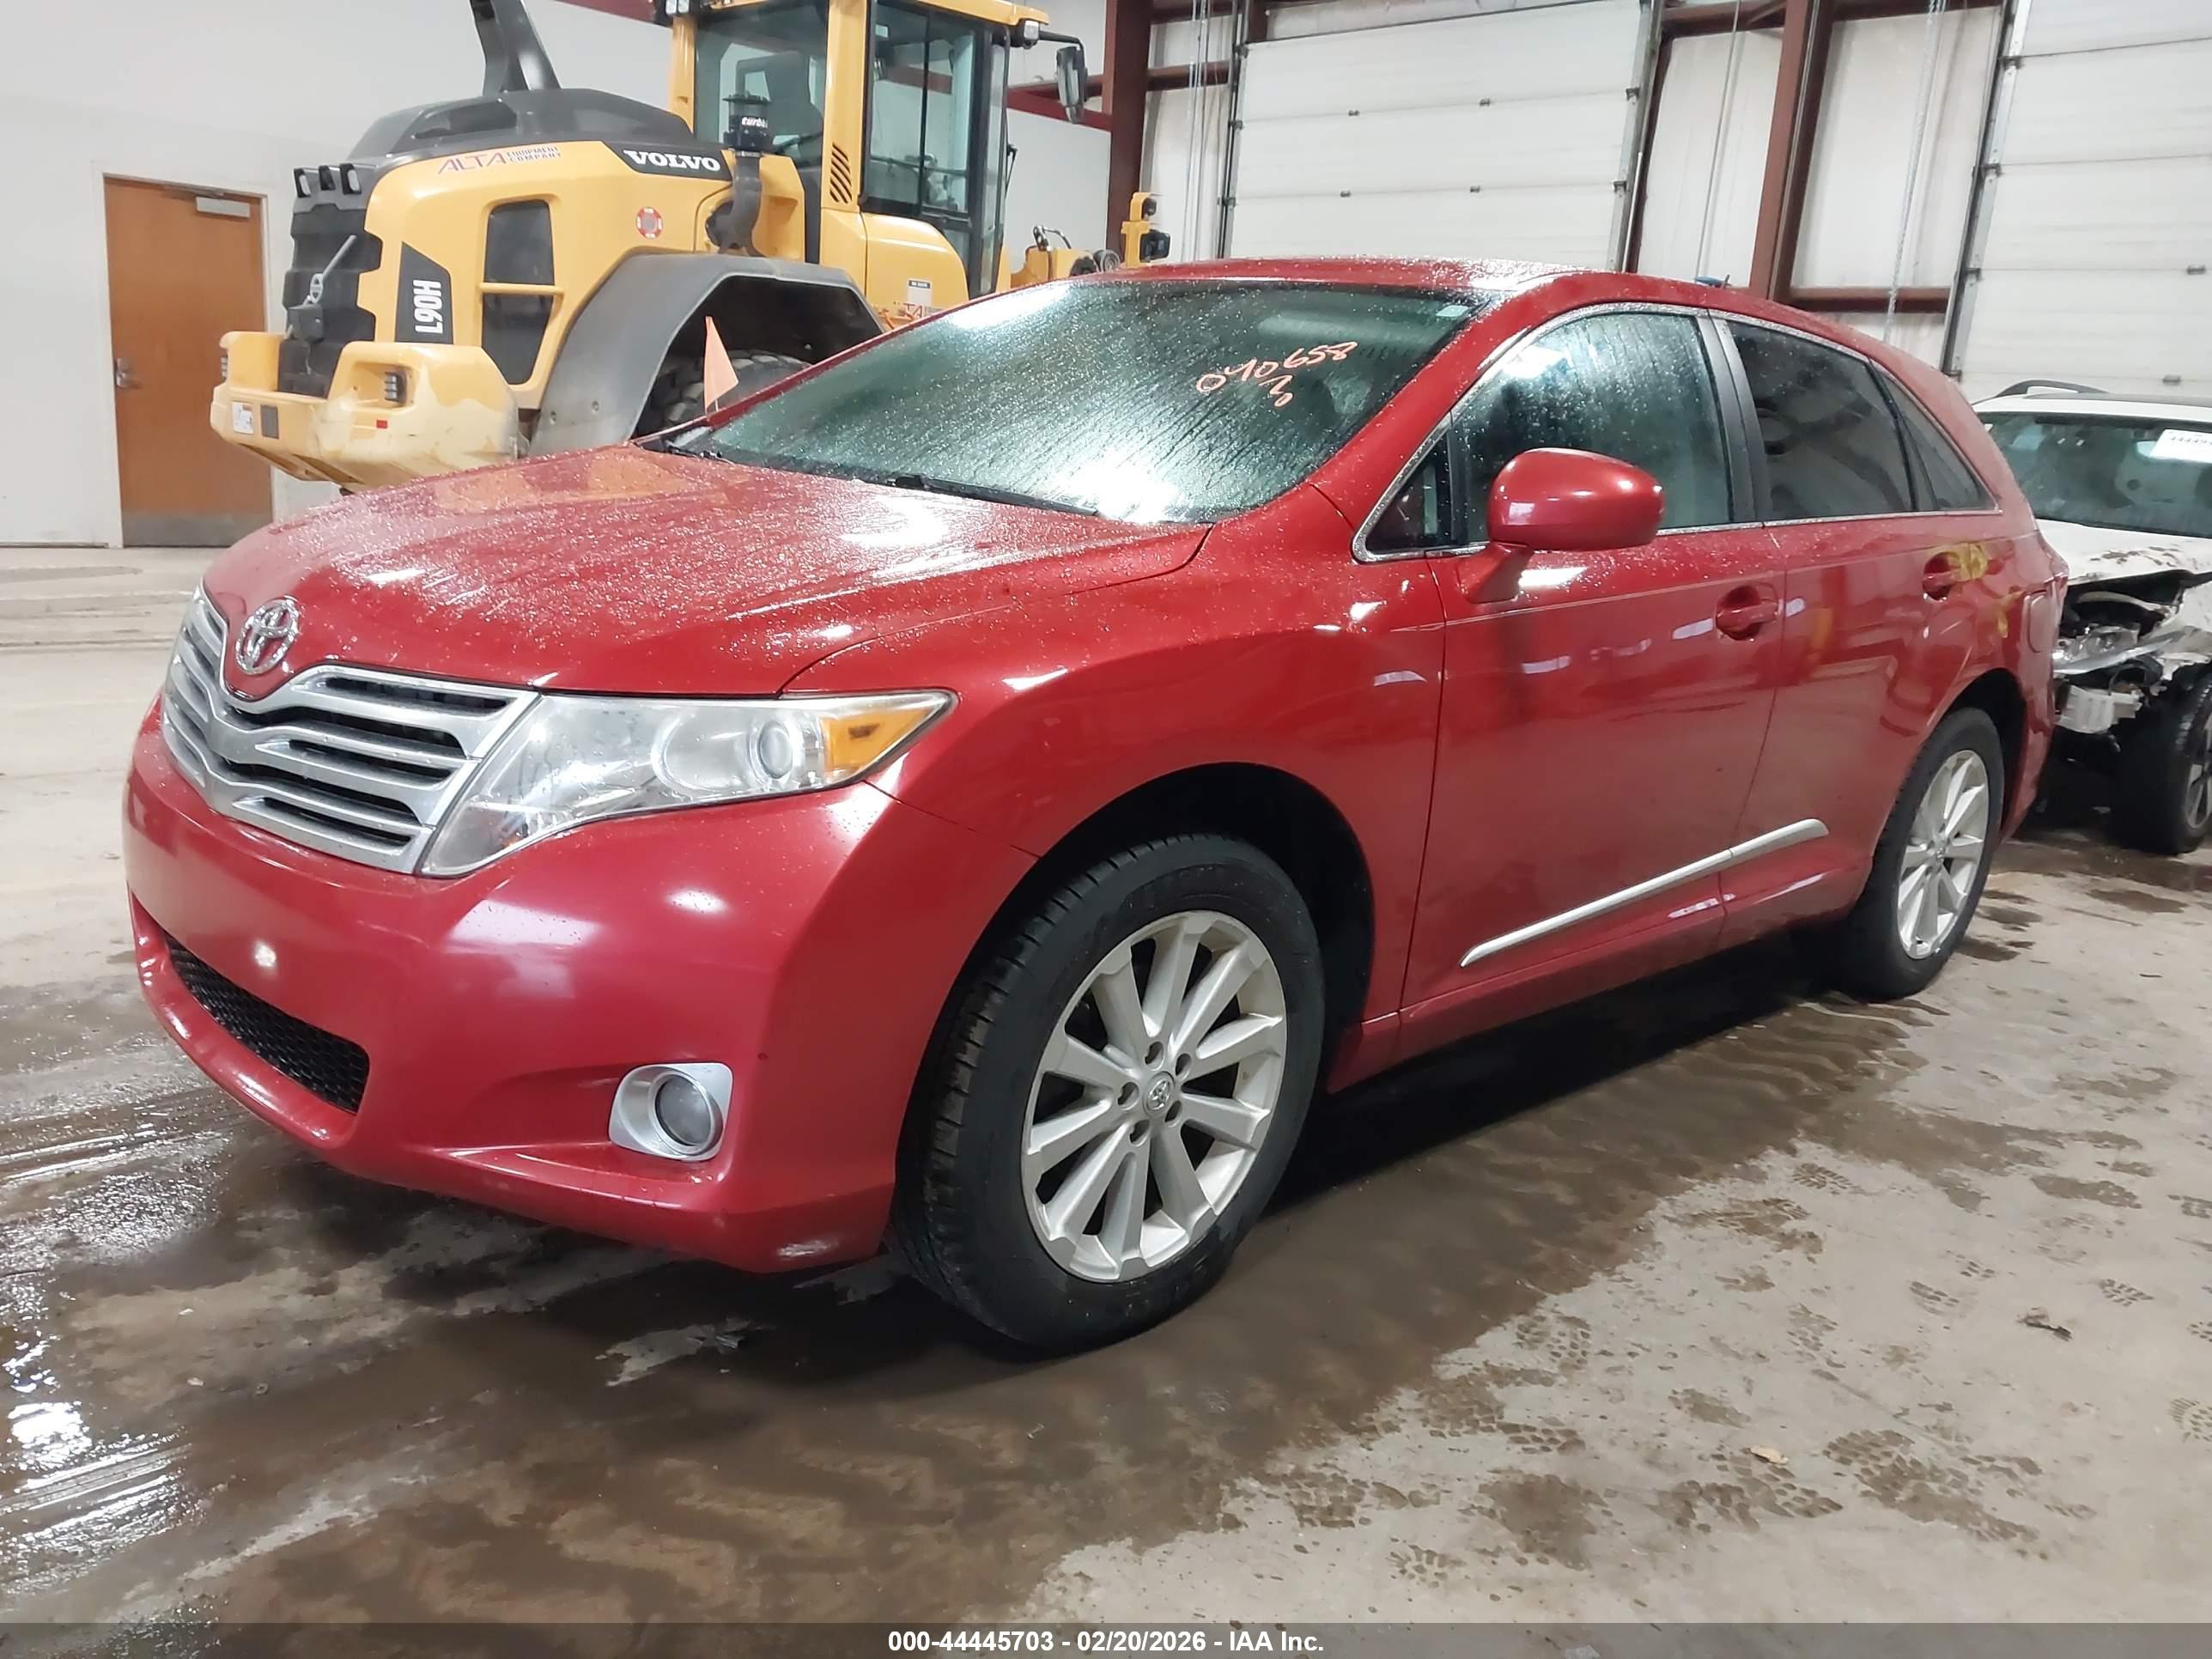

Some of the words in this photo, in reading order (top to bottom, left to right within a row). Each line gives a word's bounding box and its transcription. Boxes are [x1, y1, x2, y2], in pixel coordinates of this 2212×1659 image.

[437, 151, 507, 174] ALTA
[623, 149, 721, 172] VOLVO
[413, 279, 444, 334] L90H
